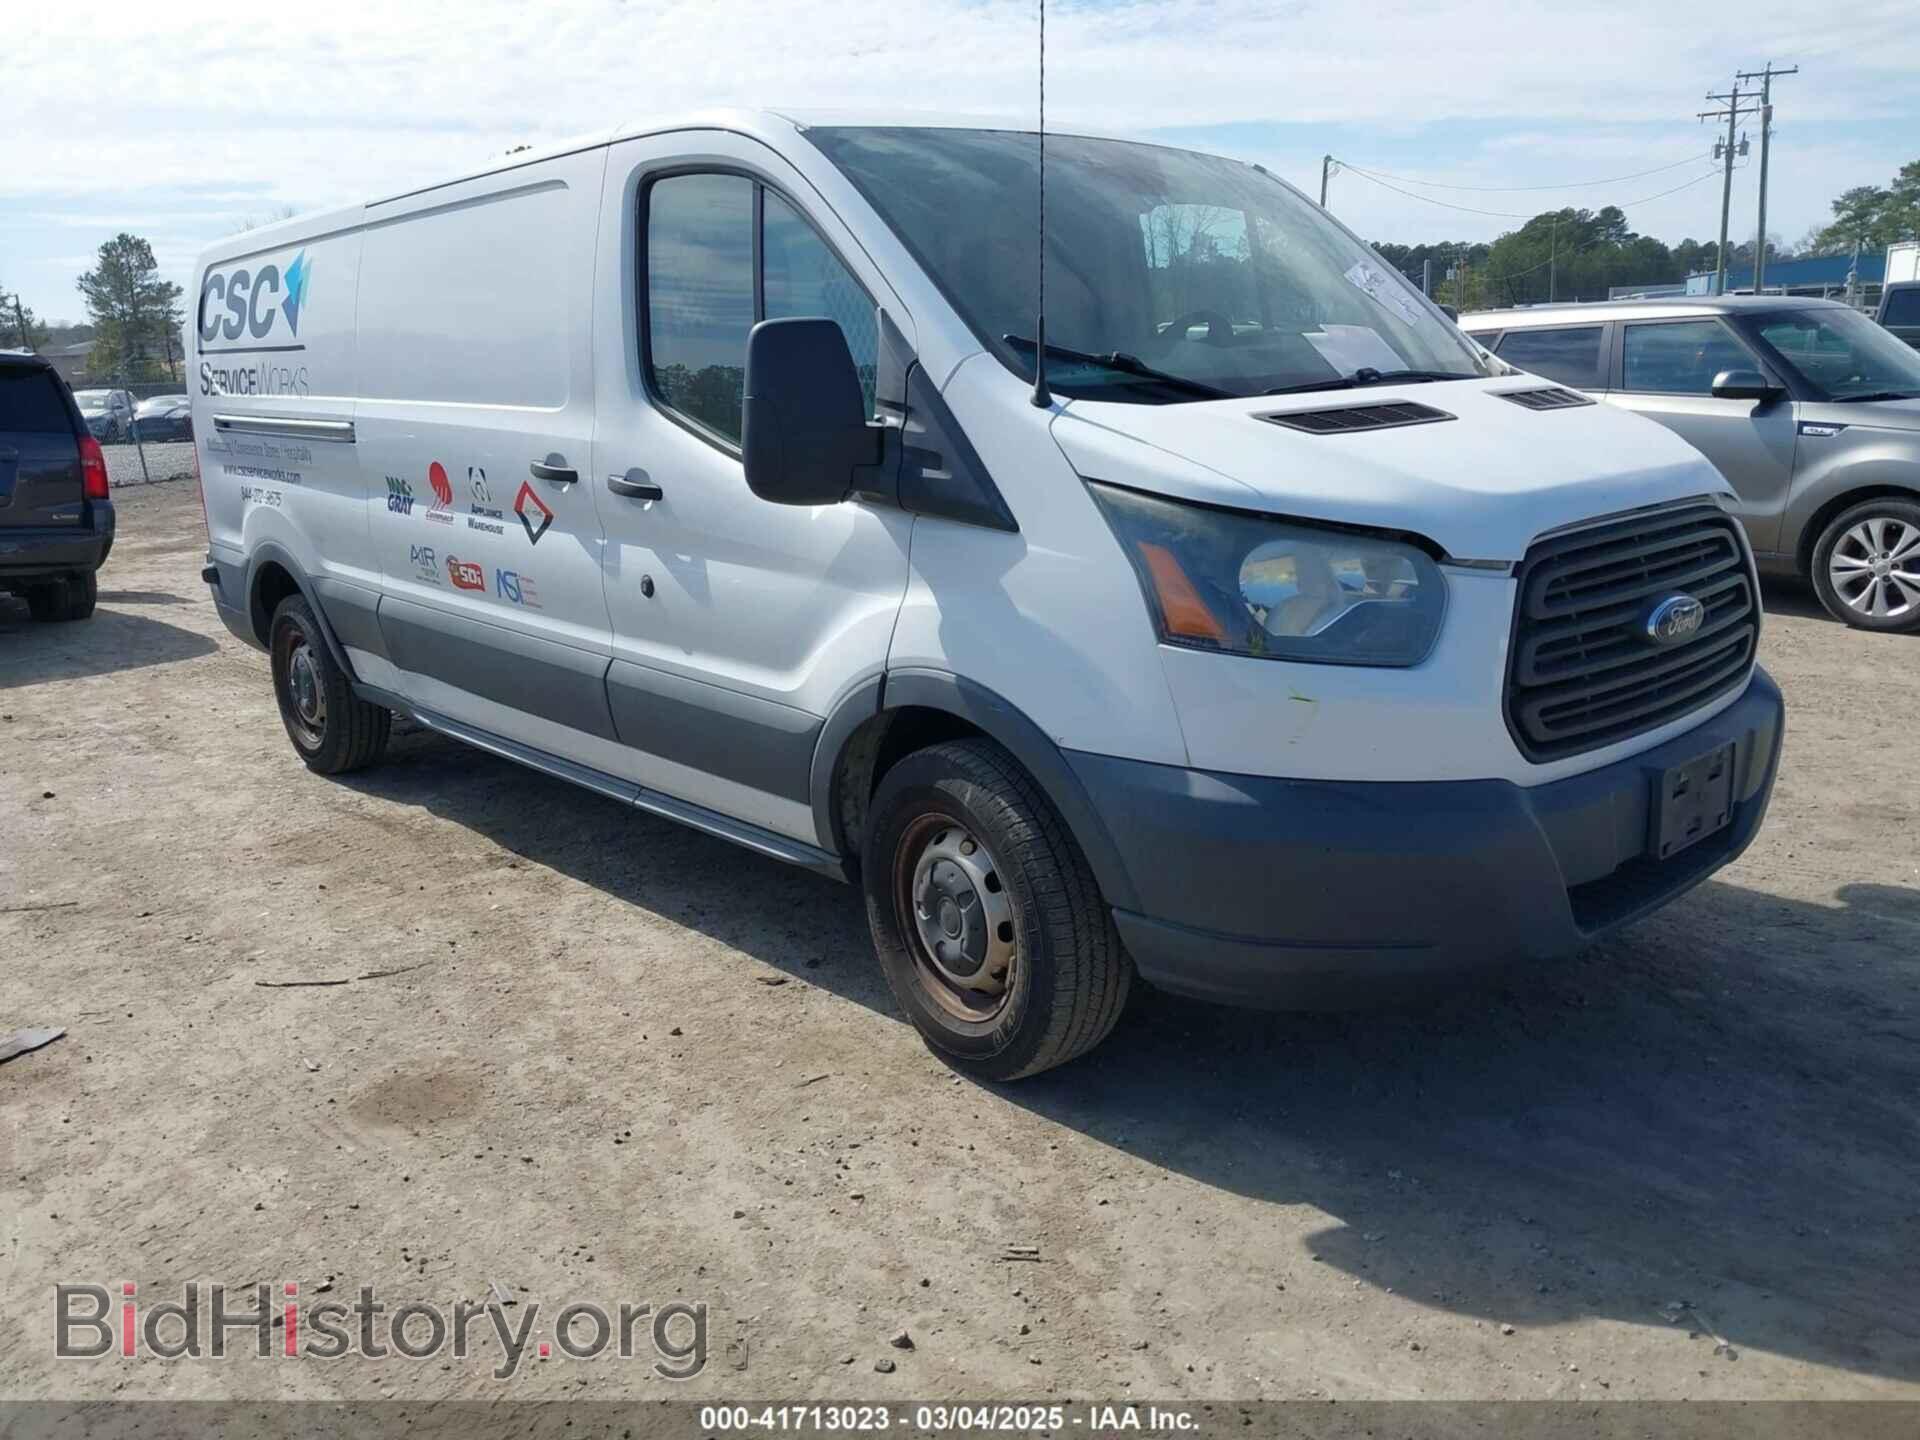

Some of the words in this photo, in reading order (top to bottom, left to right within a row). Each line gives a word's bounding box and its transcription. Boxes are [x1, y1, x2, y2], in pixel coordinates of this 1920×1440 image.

[201, 265, 279, 342] CSC
[387, 494, 414, 515] GRAY
[1668, 603, 1700, 635] Ford
